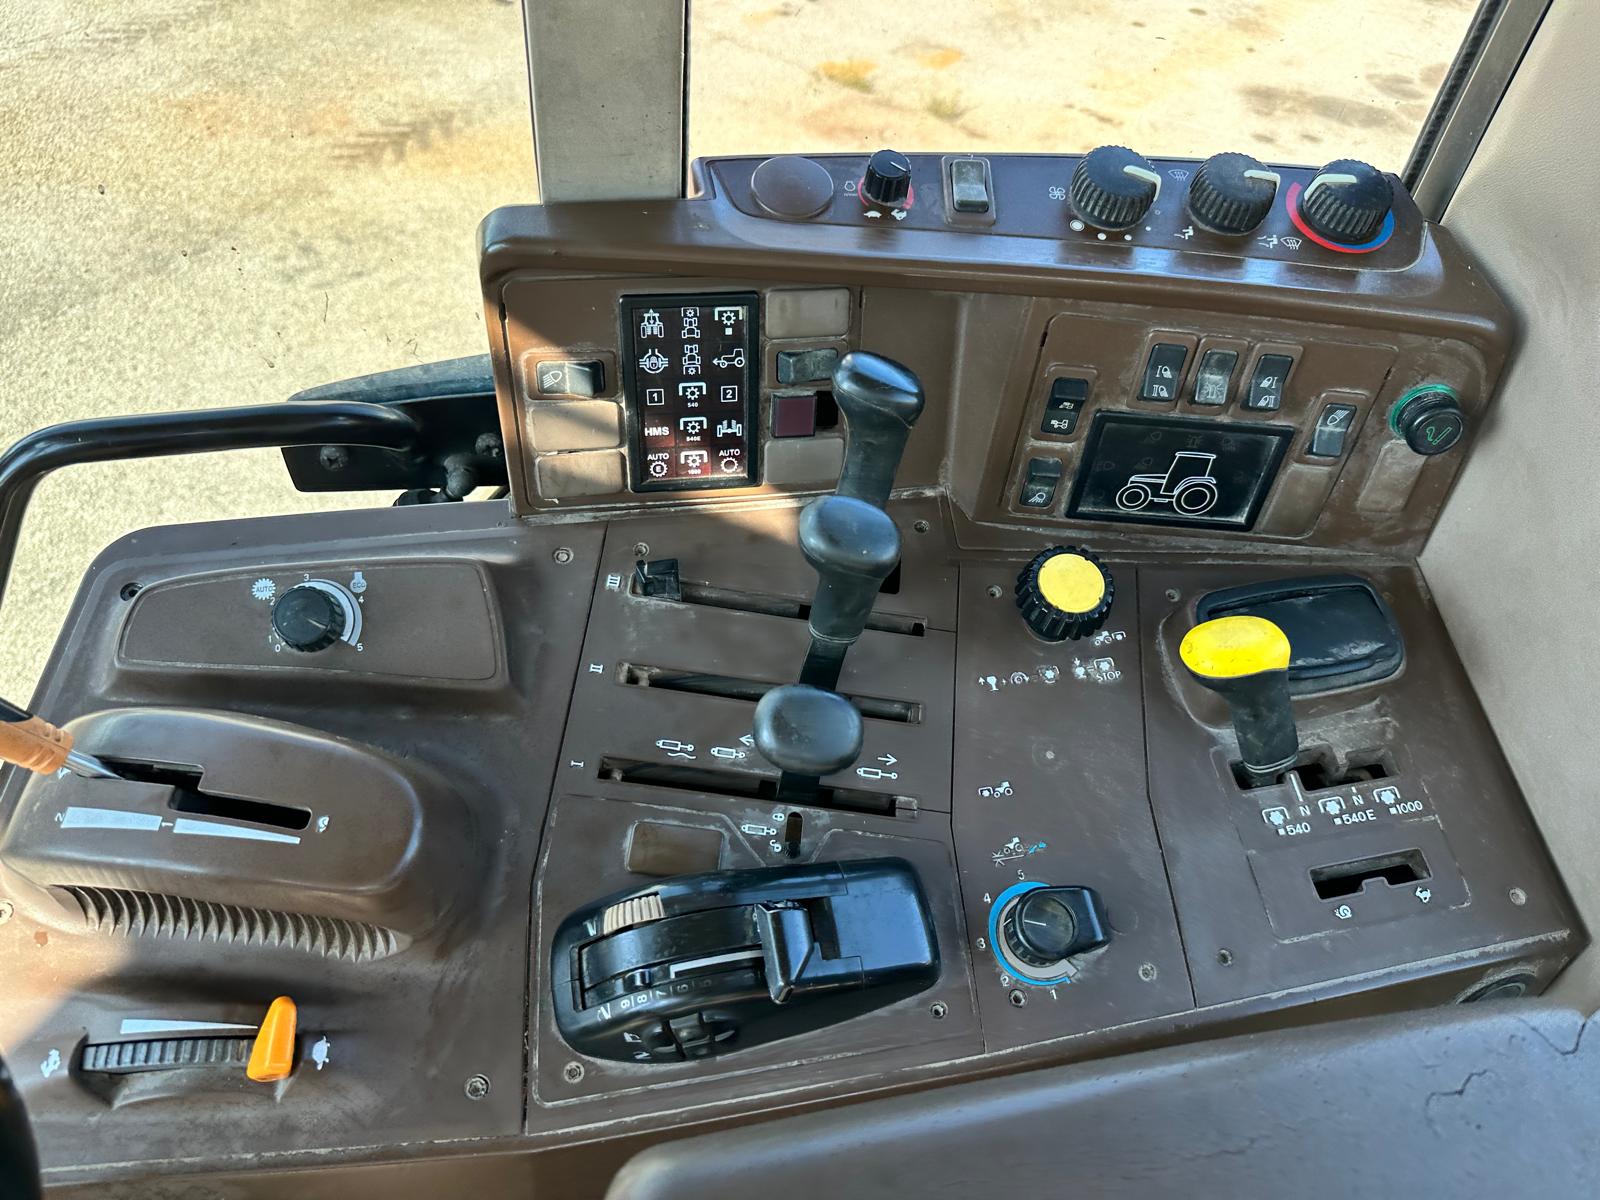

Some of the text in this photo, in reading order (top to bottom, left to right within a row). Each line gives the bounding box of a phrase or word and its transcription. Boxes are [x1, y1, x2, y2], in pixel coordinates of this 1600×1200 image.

[652, 393, 658, 402] 1
[726, 390, 733, 399] 2
[644, 426, 670, 437] HMS
[647, 453, 670, 461] AUTO
[719, 449, 741, 457] AUTO
[303, 574, 310, 582] 3
[352, 581, 366, 589] ECO
[269, 597, 276, 606] 2
[357, 643, 363, 651] 5
[1096, 670, 1121, 682] STOP
[1352, 794, 1364, 806] N
[1299, 805, 1311, 817] N
[1397, 800, 1423, 815] 1000
[1286, 822, 1311, 836] 540
[1018, 869, 1025, 880] 5
[983, 893, 991, 904] 4
[976, 938, 985, 949] 3
[1001, 975, 1010, 987] 2
[1051, 989, 1057, 1000] 1
